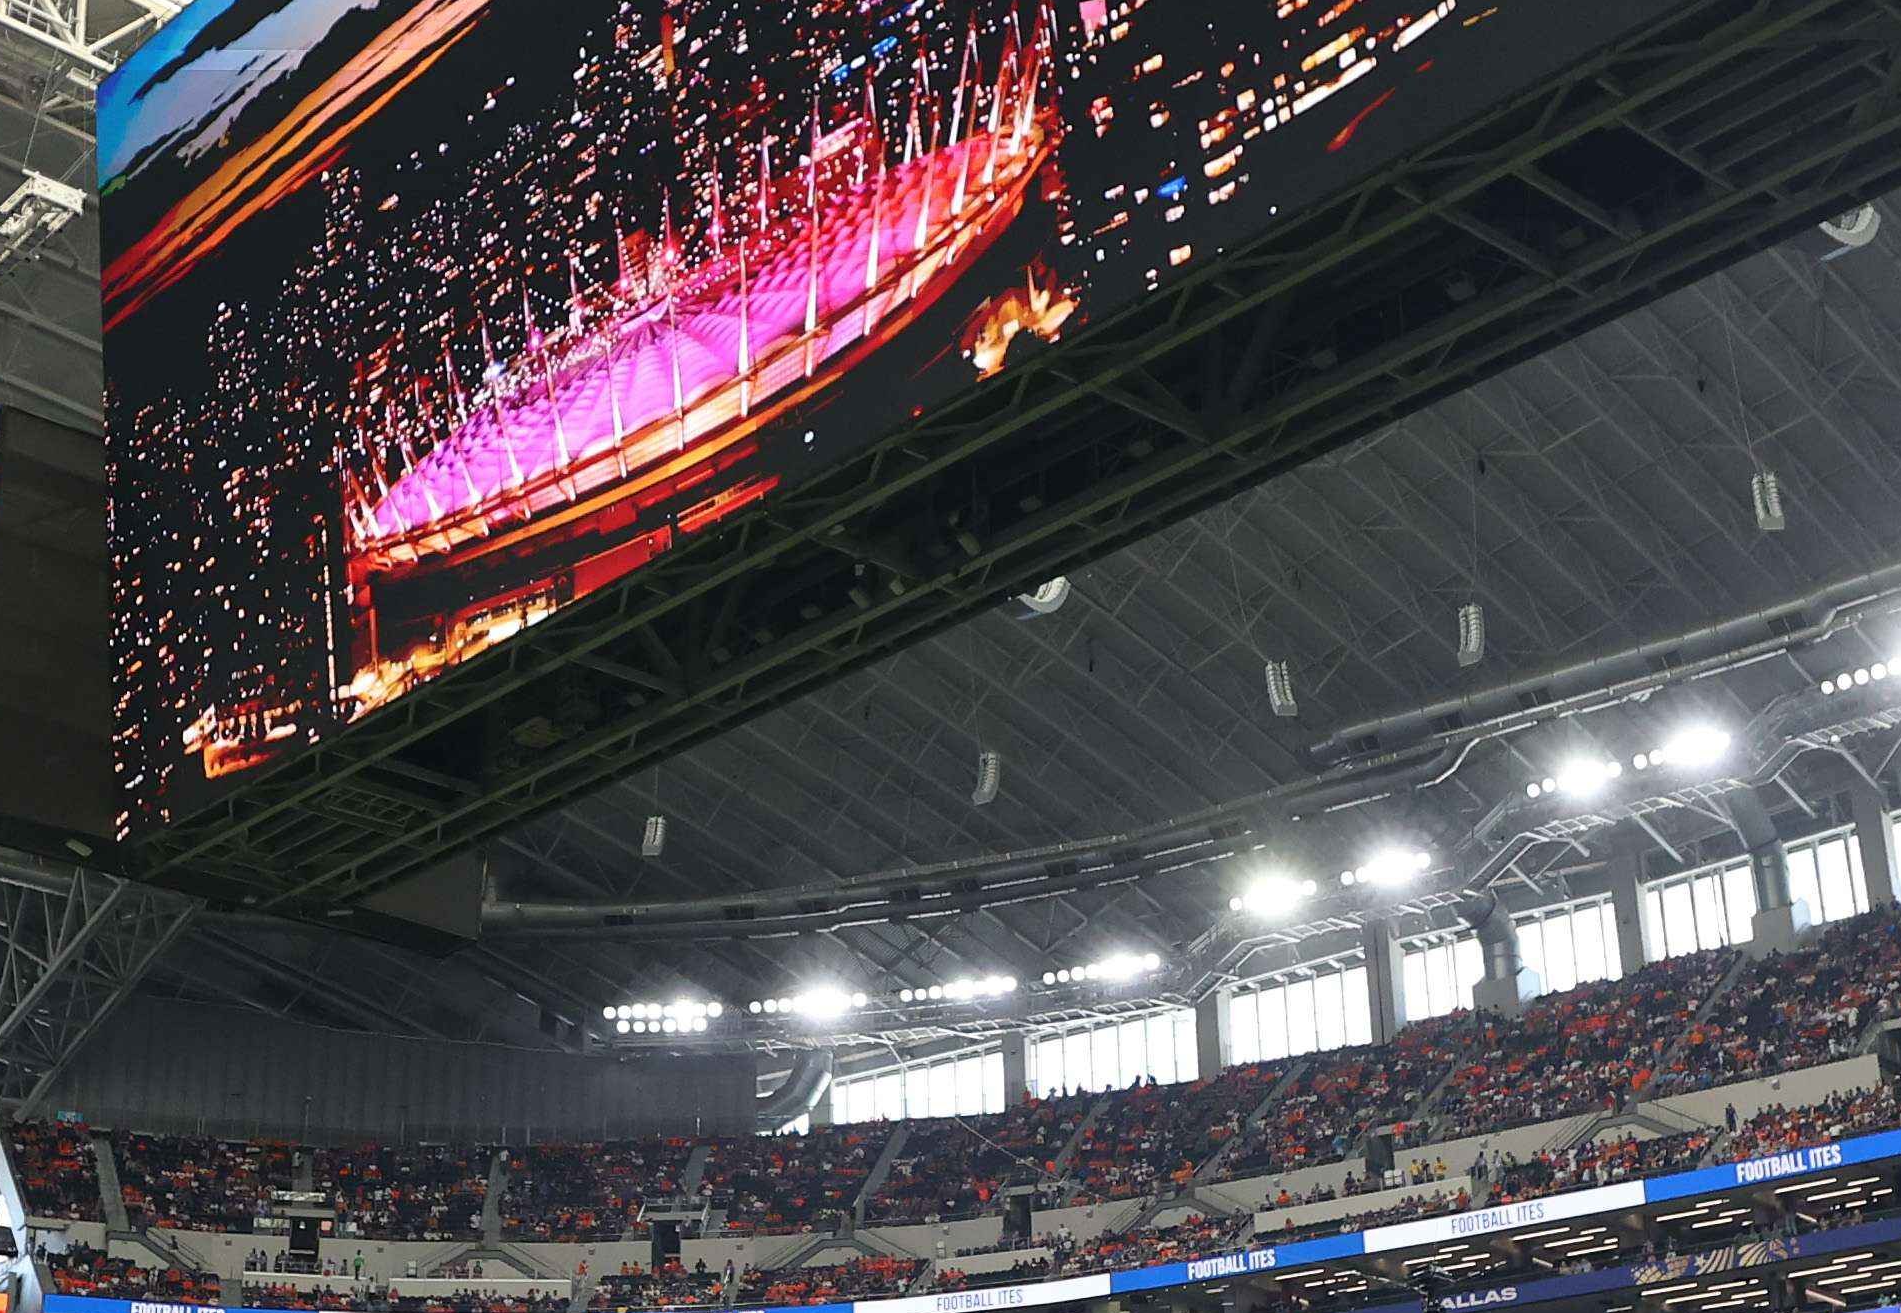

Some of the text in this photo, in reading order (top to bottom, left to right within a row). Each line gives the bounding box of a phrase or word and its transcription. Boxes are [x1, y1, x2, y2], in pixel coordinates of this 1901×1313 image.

[1736, 1152, 1805, 1183] FOOTBALL
[1451, 1207, 1511, 1234] FOOTBALL
[1187, 1251, 1246, 1280] FOOTBALL
[936, 1291, 993, 1313] FOOTBALL
[1441, 1287, 1517, 1309] ALLAS
